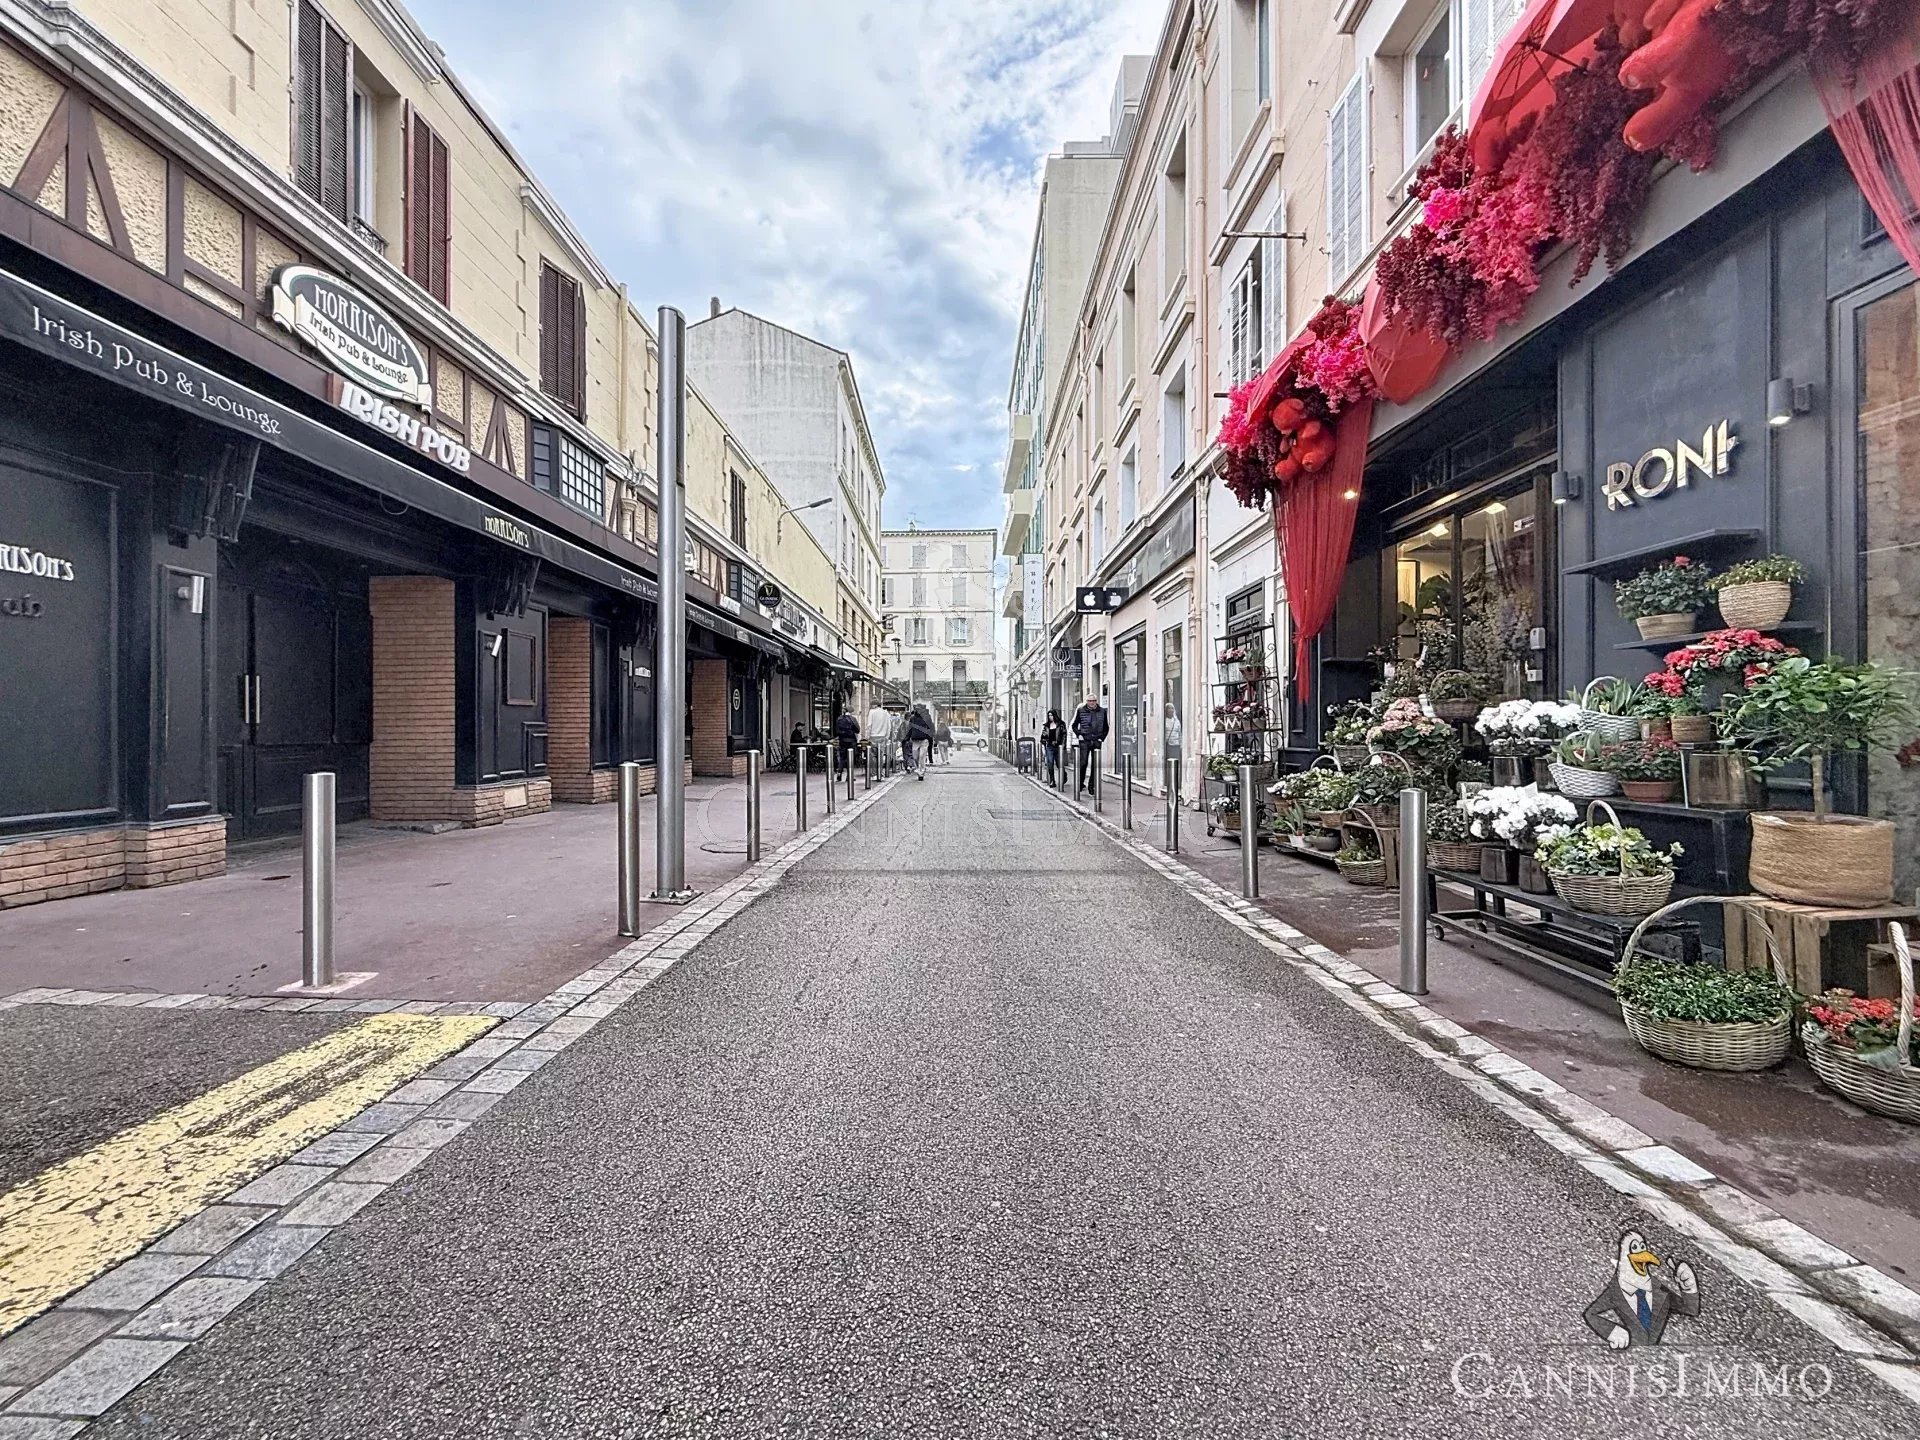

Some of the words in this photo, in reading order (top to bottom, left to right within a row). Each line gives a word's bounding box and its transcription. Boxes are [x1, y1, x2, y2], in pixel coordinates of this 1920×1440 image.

[309, 312, 336, 343] Irish
[338, 334, 360, 360] Pub
[361, 352, 371, 366] &
[371, 357, 409, 384] Lounge
[314, 284, 408, 367] MORRISON'S
[33, 306, 103, 359] Irish
[112, 342, 169, 386] Pub
[176, 372, 195, 398] &
[201, 382, 282, 435] Lounge
[339, 381, 421, 446] IRISH
[420, 426, 471, 472] PUB
[484, 515, 529, 548] MORRISON'S
